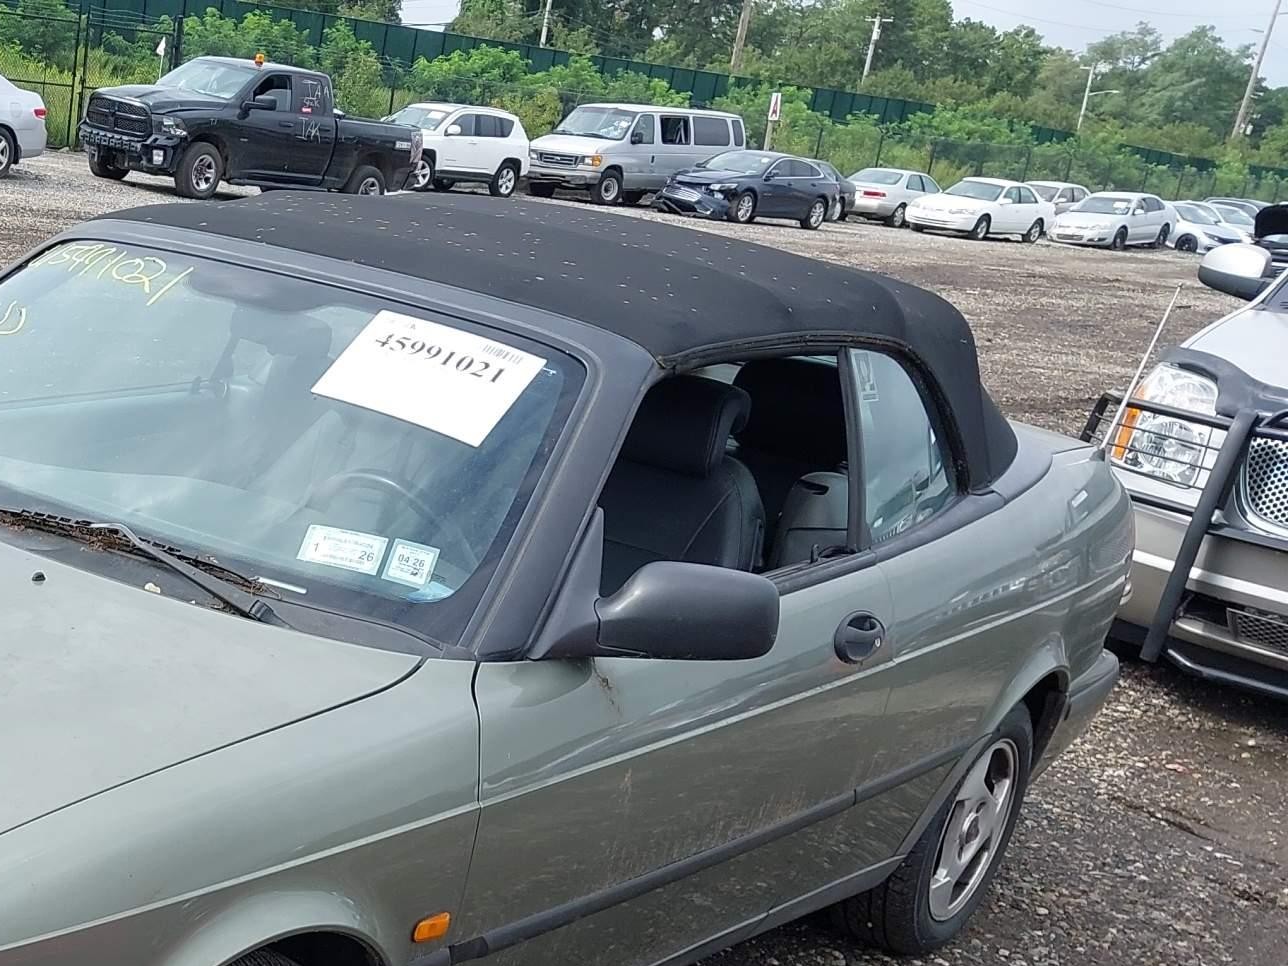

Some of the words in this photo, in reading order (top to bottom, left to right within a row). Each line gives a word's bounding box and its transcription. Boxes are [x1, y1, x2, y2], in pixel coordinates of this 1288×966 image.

[769, 94, 780, 118] A
[374, 332, 507, 384] 45991021
[357, 550, 375, 562] 26
[398, 553, 410, 563] 04
[412, 558, 425, 568] 26
